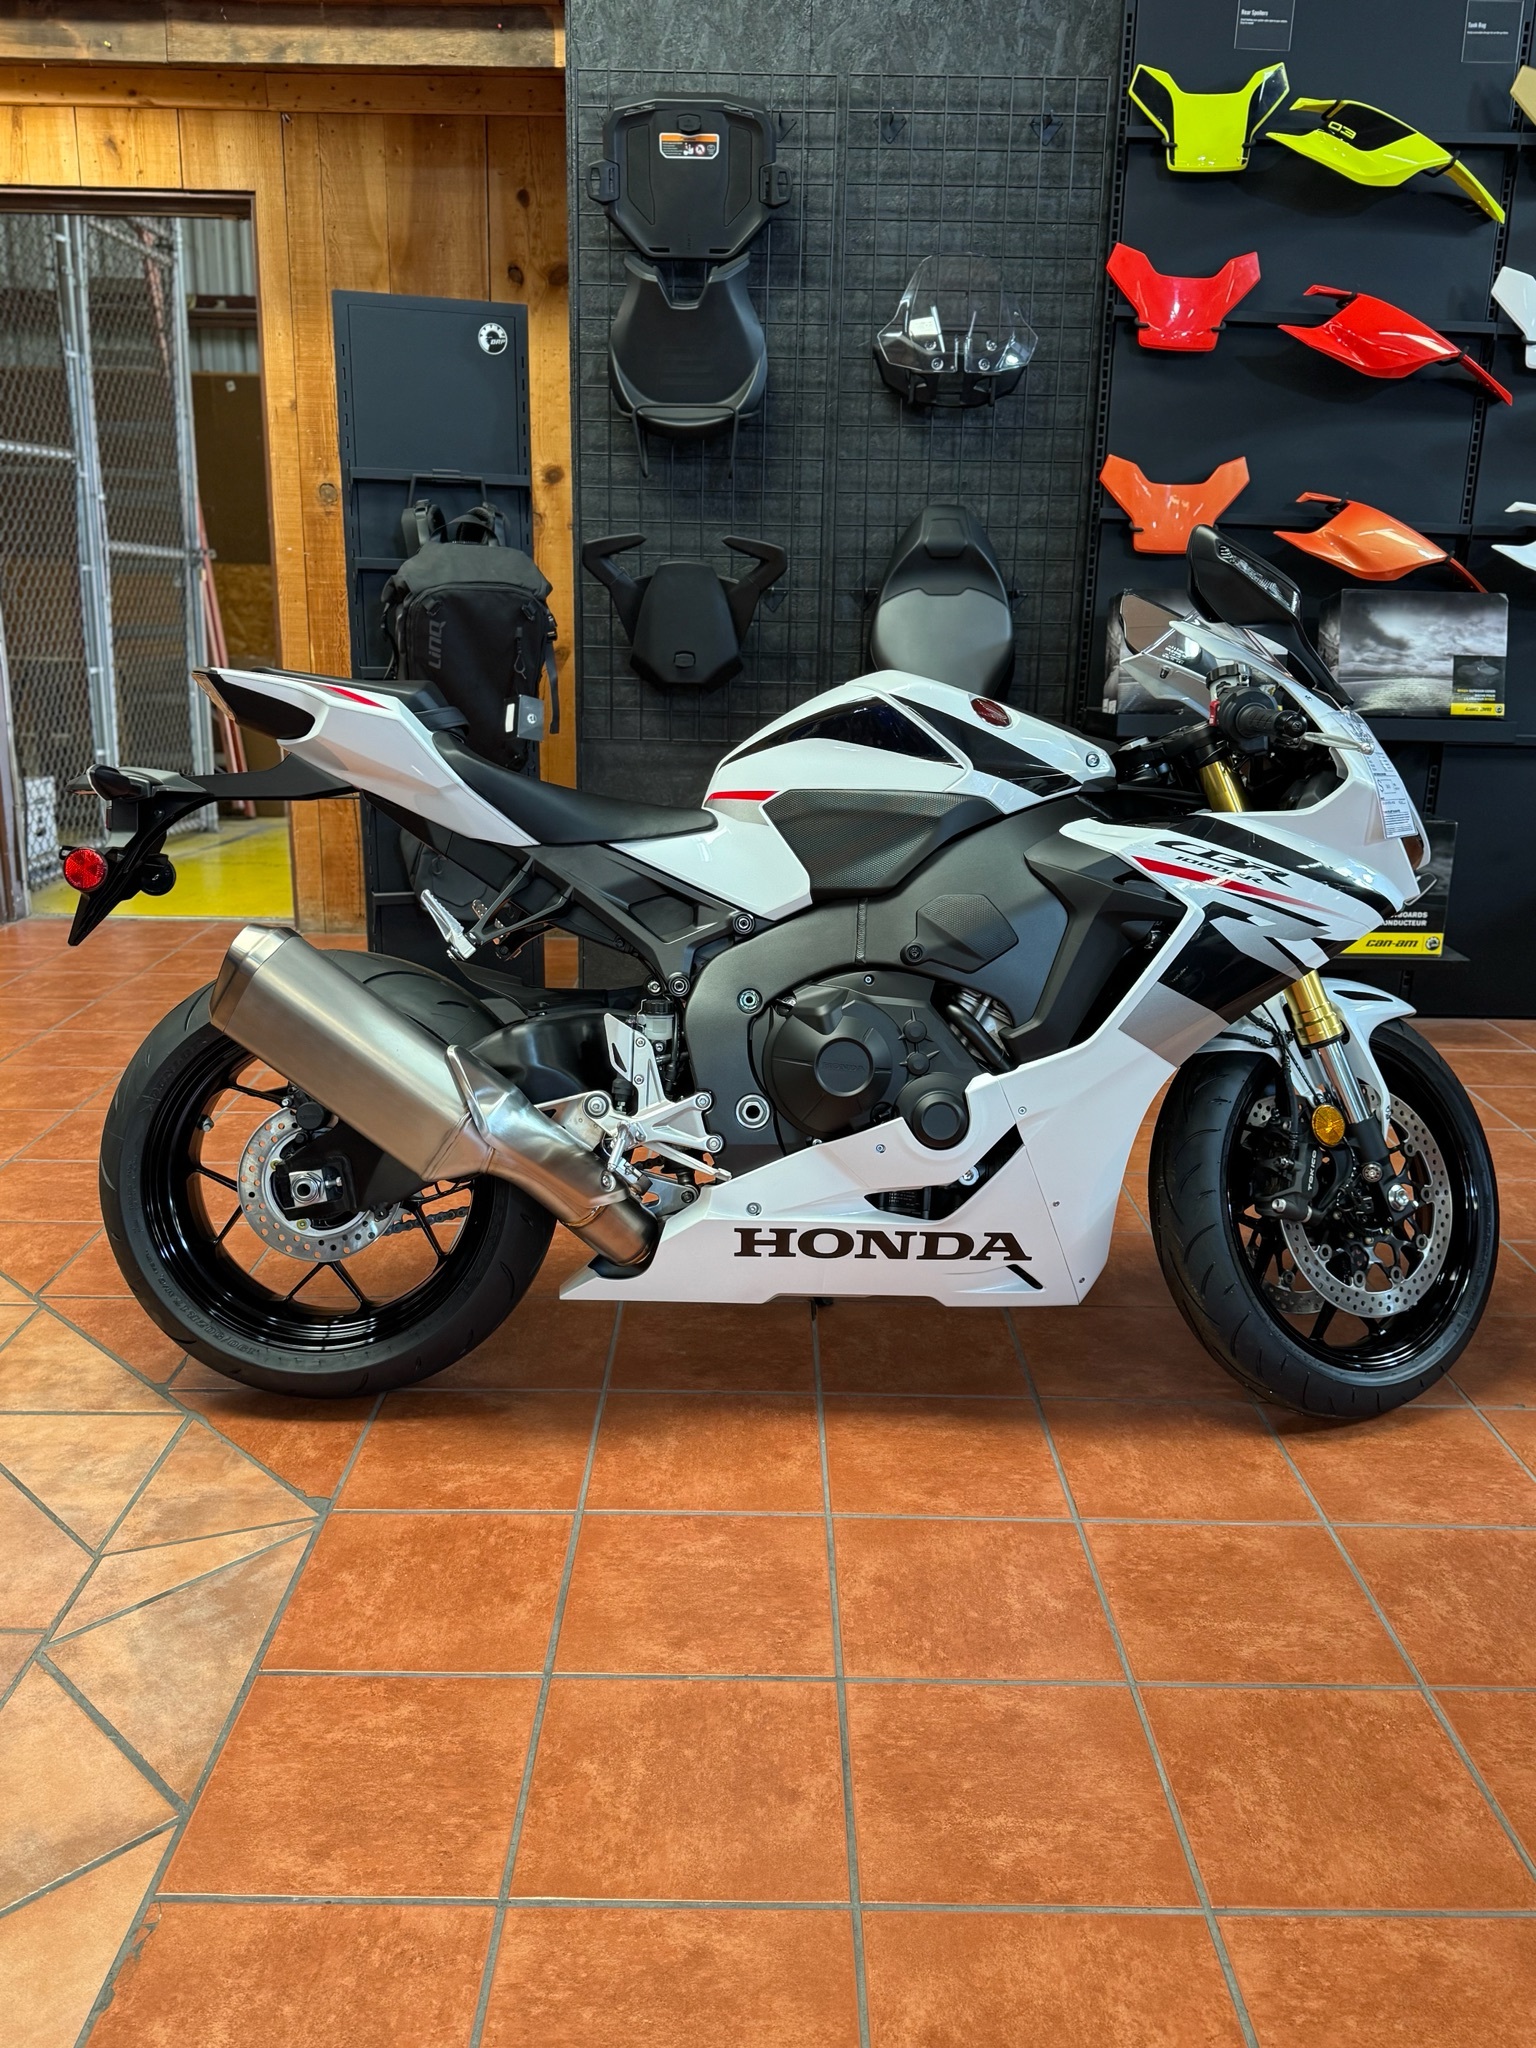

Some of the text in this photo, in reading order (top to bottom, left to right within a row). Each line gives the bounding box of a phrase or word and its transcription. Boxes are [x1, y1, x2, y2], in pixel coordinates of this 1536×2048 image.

[1327, 120, 1357, 140] 03
[1154, 840, 1293, 889] CBR
[1382, 919, 1428, 927] ONDUCTEUR
[1365, 939, 1419, 948] can-am
[822, 1061, 869, 1073] HONDA
[1307, 1149, 1317, 1191] TOKICO
[733, 1227, 1033, 1261] HONDA
